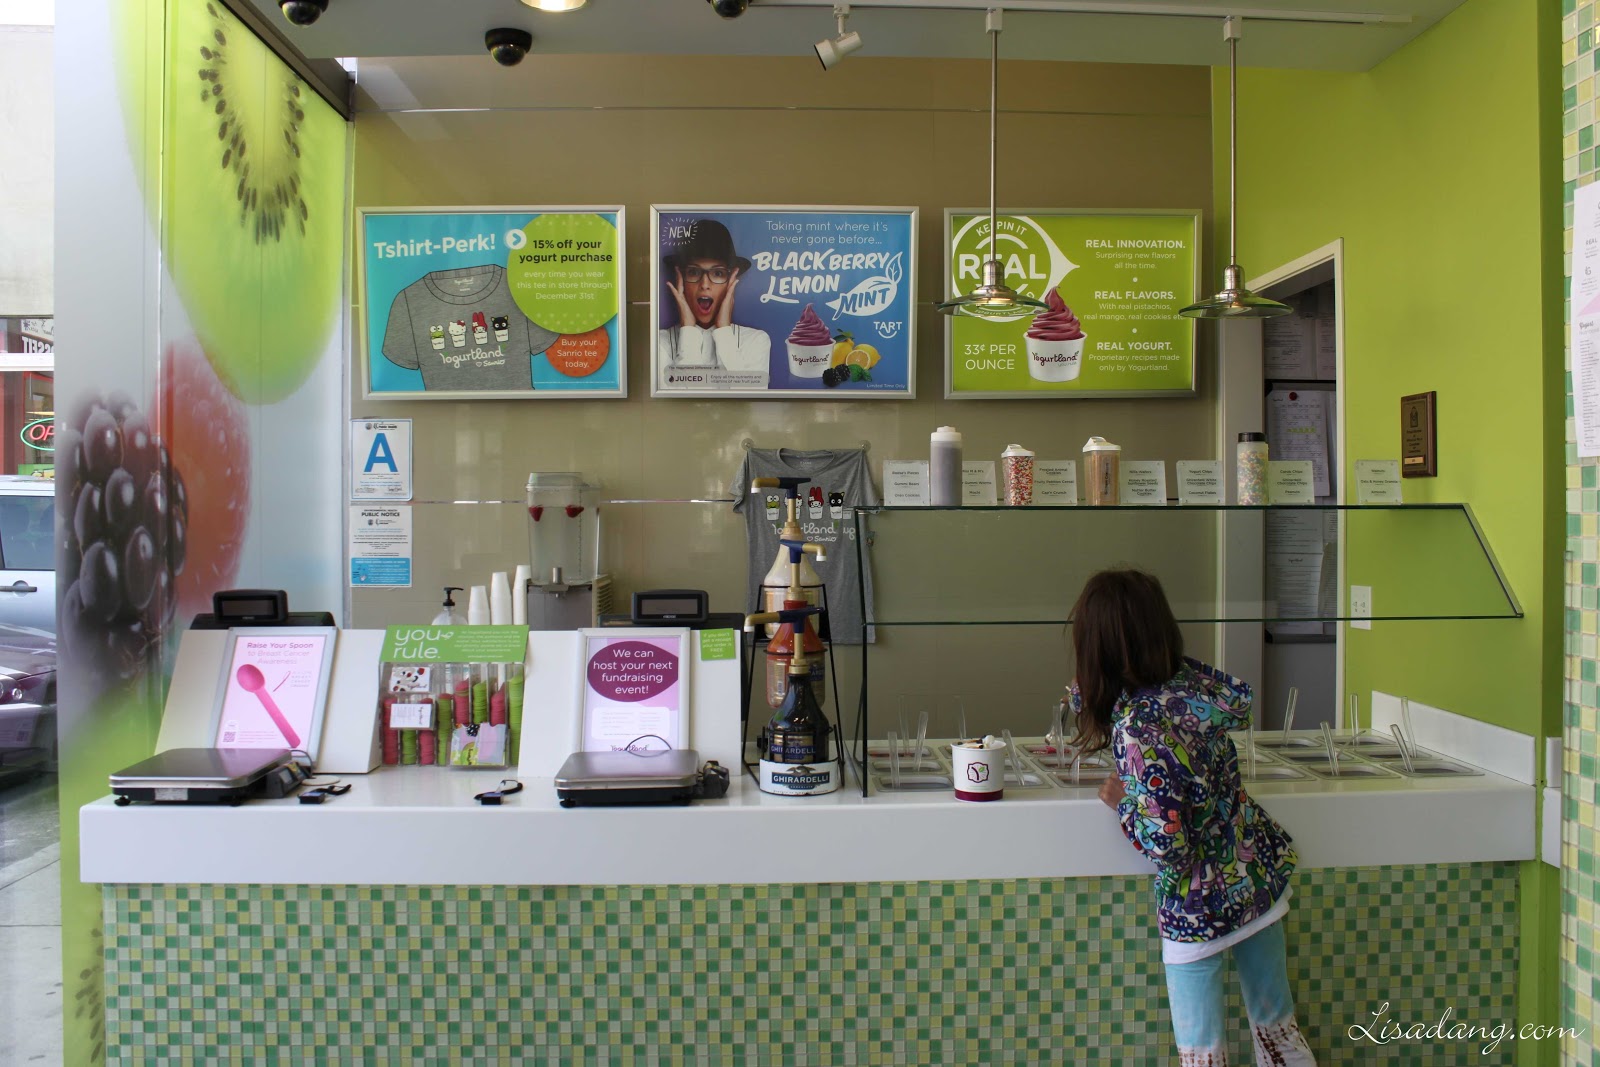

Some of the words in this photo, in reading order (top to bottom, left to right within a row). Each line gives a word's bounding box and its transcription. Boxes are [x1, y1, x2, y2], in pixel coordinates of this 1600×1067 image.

[669, 225, 692, 239] NEW
[766, 221, 802, 232] Taking
[806, 221, 830, 230] mint
[835, 221, 869, 231] where
[873, 221, 888, 231] it's
[976, 221, 1014, 236] KEPIN
[1016, 225, 1027, 235] IT
[374, 234, 495, 258] Tshirt-Perk!
[533, 240, 554, 249] 15%
[557, 240, 572, 248] off
[576, 241, 602, 251] your
[772, 236, 802, 244] never
[807, 236, 835, 246] gone
[839, 235, 882, 244] before...
[1086, 240, 1113, 248] REAL
[1117, 240, 1186, 249] INNOVATION.
[519, 254, 556, 263] yogurt
[561, 253, 612, 263] purchase
[1096, 252, 1132, 260] Surprising
[959, 254, 1046, 279] RAL
[580, 281, 612, 290] through
[760, 275, 840, 304] LEMON
[1126, 291, 1176, 300] FLAVORS.
[832, 288, 890, 320] MINT
[1134, 303, 1172, 312] pistachios,
[874, 322, 902, 333] TART
[964, 344, 985, 356] 33¢
[990, 345, 1016, 355] PER
[792, 354, 830, 369] Yogurtland
[1032, 352, 1077, 368] Yogurtland
[1089, 354, 1130, 362] Proprietary
[565, 360, 589, 369] today.
[966, 360, 1014, 370] OUNCE
[1099, 364, 1114, 373] only
[1129, 364, 1169, 373] Yogurtland.
[364, 433, 398, 472] A
[395, 630, 441, 646] you
[393, 642, 440, 659] rule.
[613, 649, 631, 658] We
[593, 661, 617, 670] host
[620, 662, 645, 672] your
[648, 662, 673, 670] next
[602, 673, 663, 684] fundraising
[615, 685, 648, 694] event!
[773, 775, 828, 783] GHIRARDELLI
